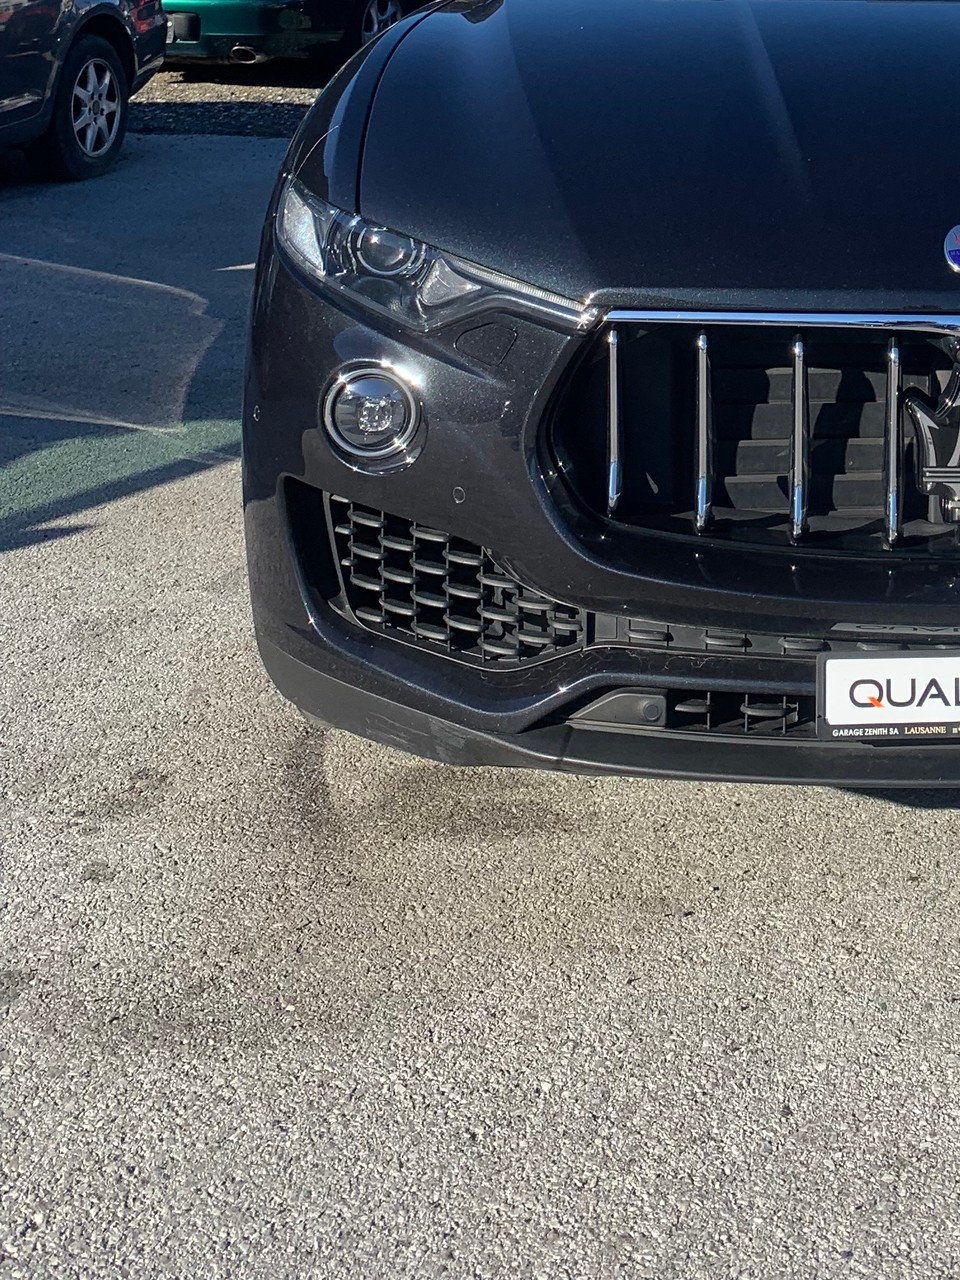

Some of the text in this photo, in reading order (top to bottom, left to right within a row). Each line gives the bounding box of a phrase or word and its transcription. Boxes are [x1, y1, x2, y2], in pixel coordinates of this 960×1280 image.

[832, 728, 864, 737] GARAGE
[864, 727, 888, 736] ZENITH
[889, 727, 899, 735] SA
[904, 726, 947, 735] LAUSANNE
